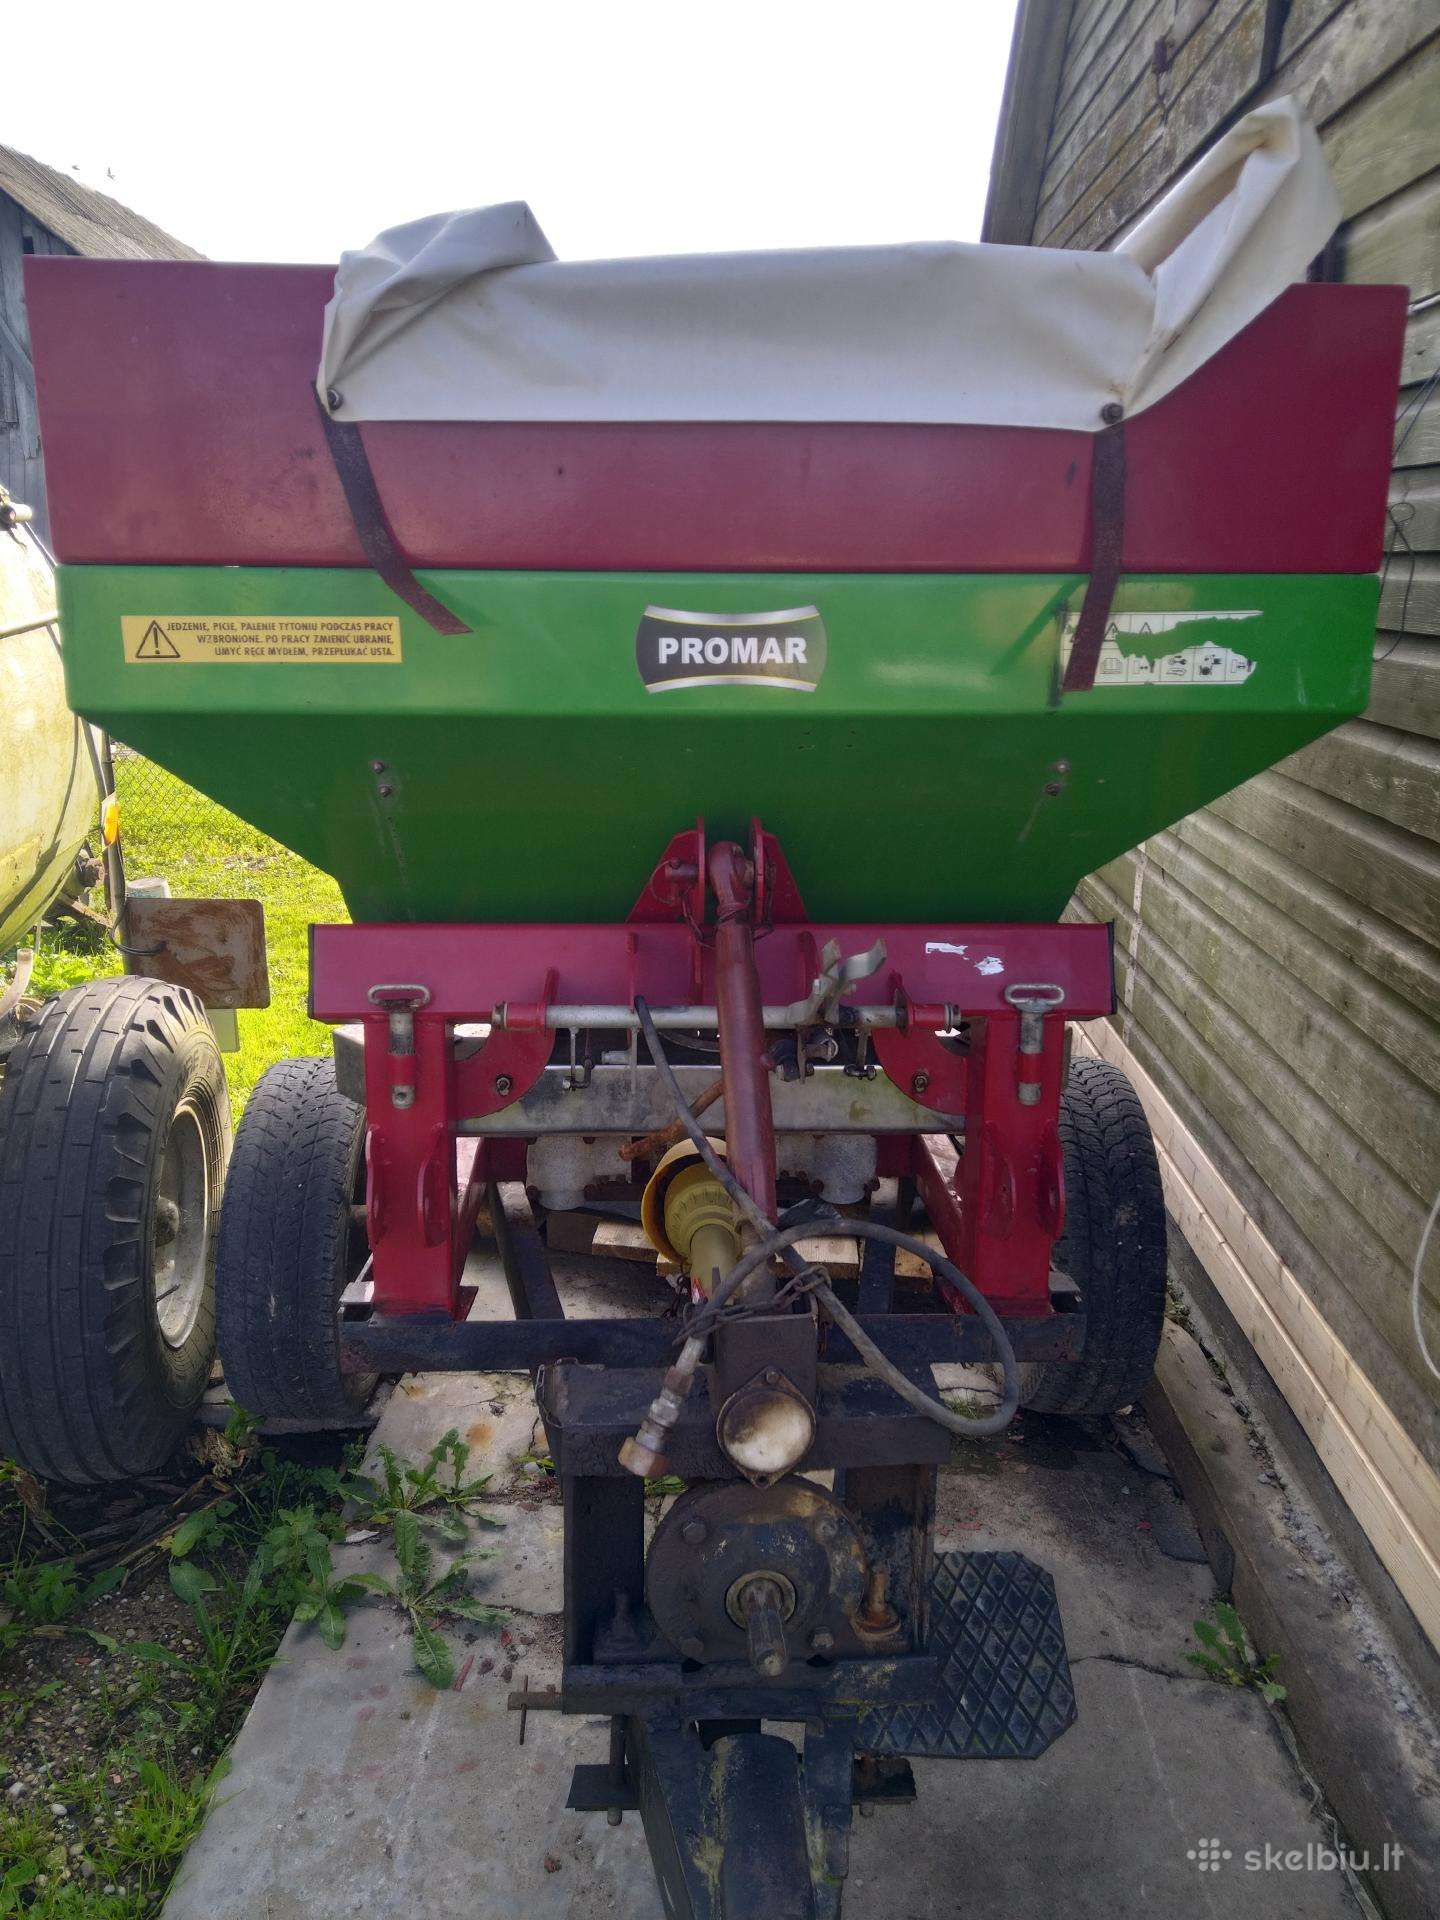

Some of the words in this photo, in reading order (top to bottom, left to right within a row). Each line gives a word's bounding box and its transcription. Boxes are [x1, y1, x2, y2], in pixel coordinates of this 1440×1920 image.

[279, 622, 317, 631] TYTONIU
[320, 622, 362, 631] PODCZAS
[364, 622, 393, 631] PRACY
[266, 635, 278, 643] PO
[281, 635, 310, 643] PRACY
[370, 647, 395, 656] USTA.
[658, 637, 808, 665] PROMAR
